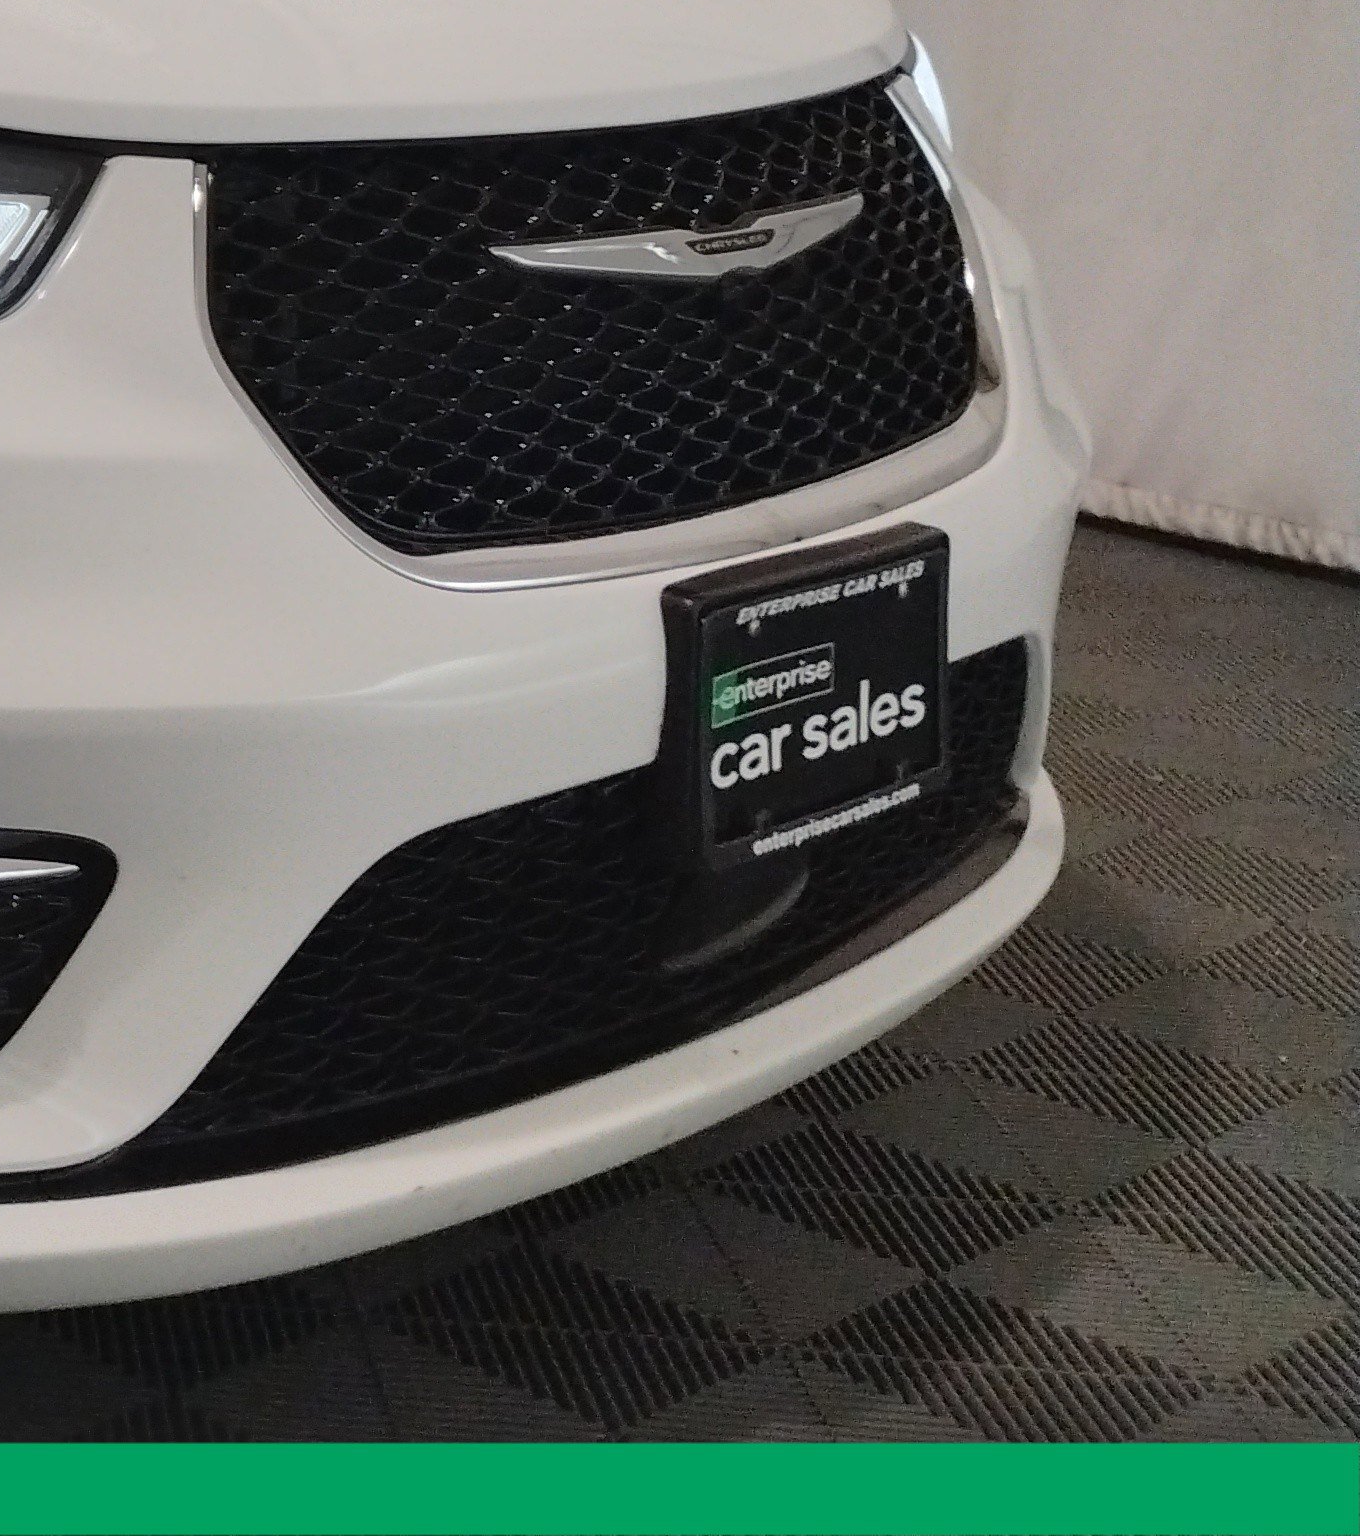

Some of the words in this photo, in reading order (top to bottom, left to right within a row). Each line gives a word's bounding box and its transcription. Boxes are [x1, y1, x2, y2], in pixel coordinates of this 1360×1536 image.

[736, 583, 843, 625] ENTERPRISE
[842, 574, 878, 597] CAR
[878, 559, 925, 589] SALES
[715, 659, 833, 710] enterprise
[710, 722, 792, 790] car
[802, 679, 926, 760] sales
